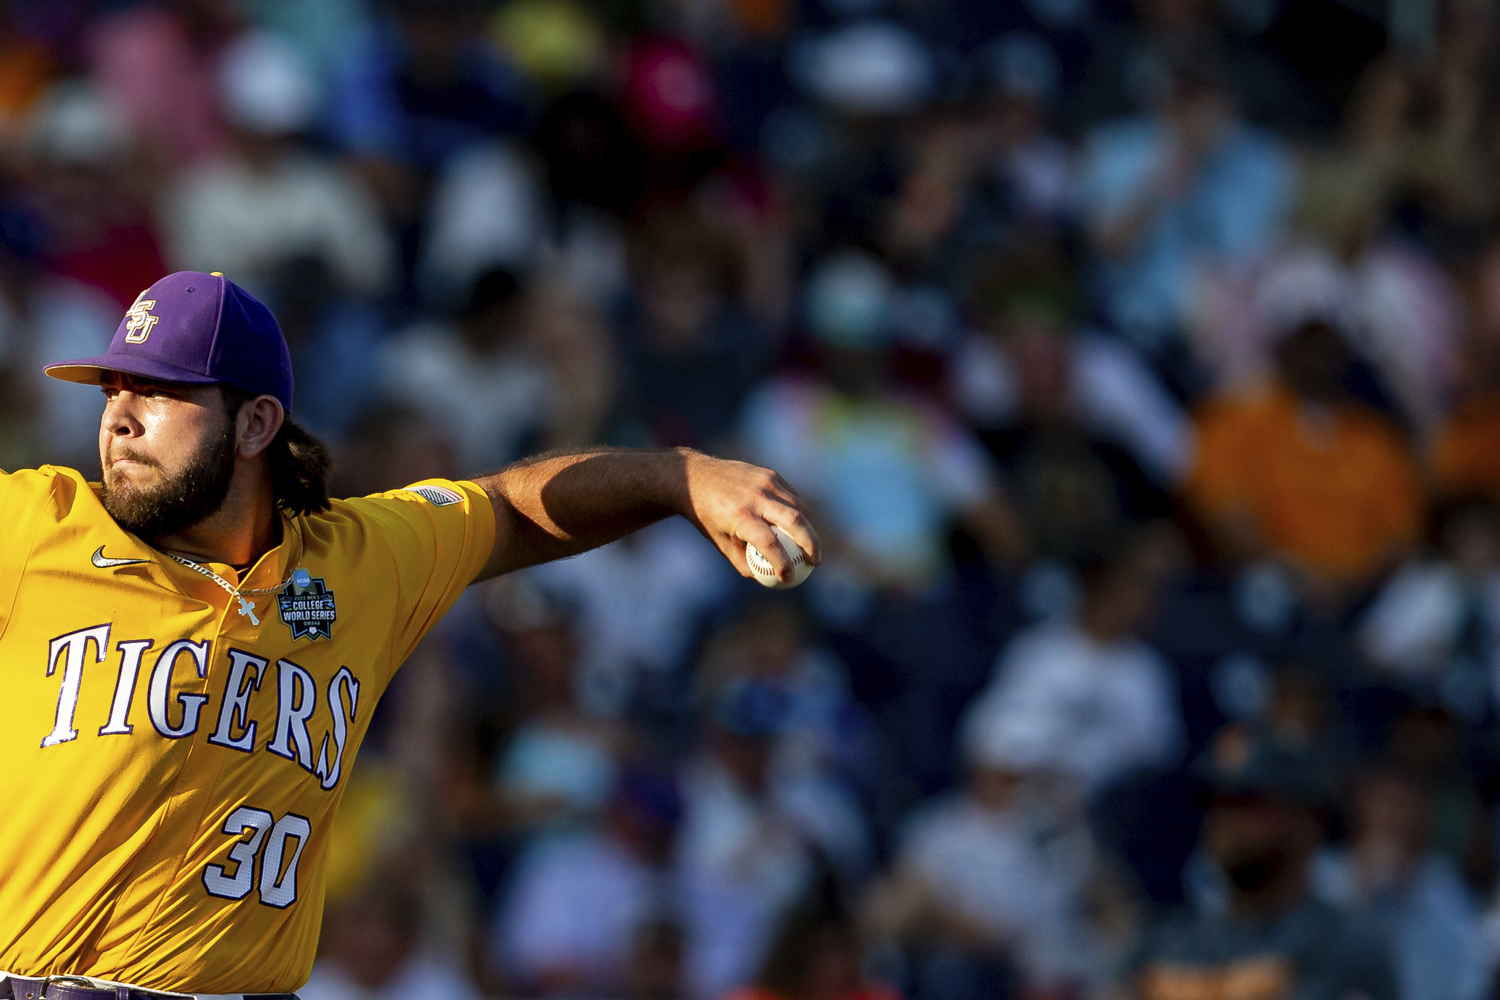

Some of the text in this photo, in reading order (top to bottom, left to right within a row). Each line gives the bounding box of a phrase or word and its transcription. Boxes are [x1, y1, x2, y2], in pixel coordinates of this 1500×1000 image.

[125, 288, 159, 344] LSU
[283, 610, 335, 621] WORLD SERIES
[293, 600, 324, 610] COLLEGE
[40, 622, 360, 791] TIGERS
[202, 805, 311, 909] 30
